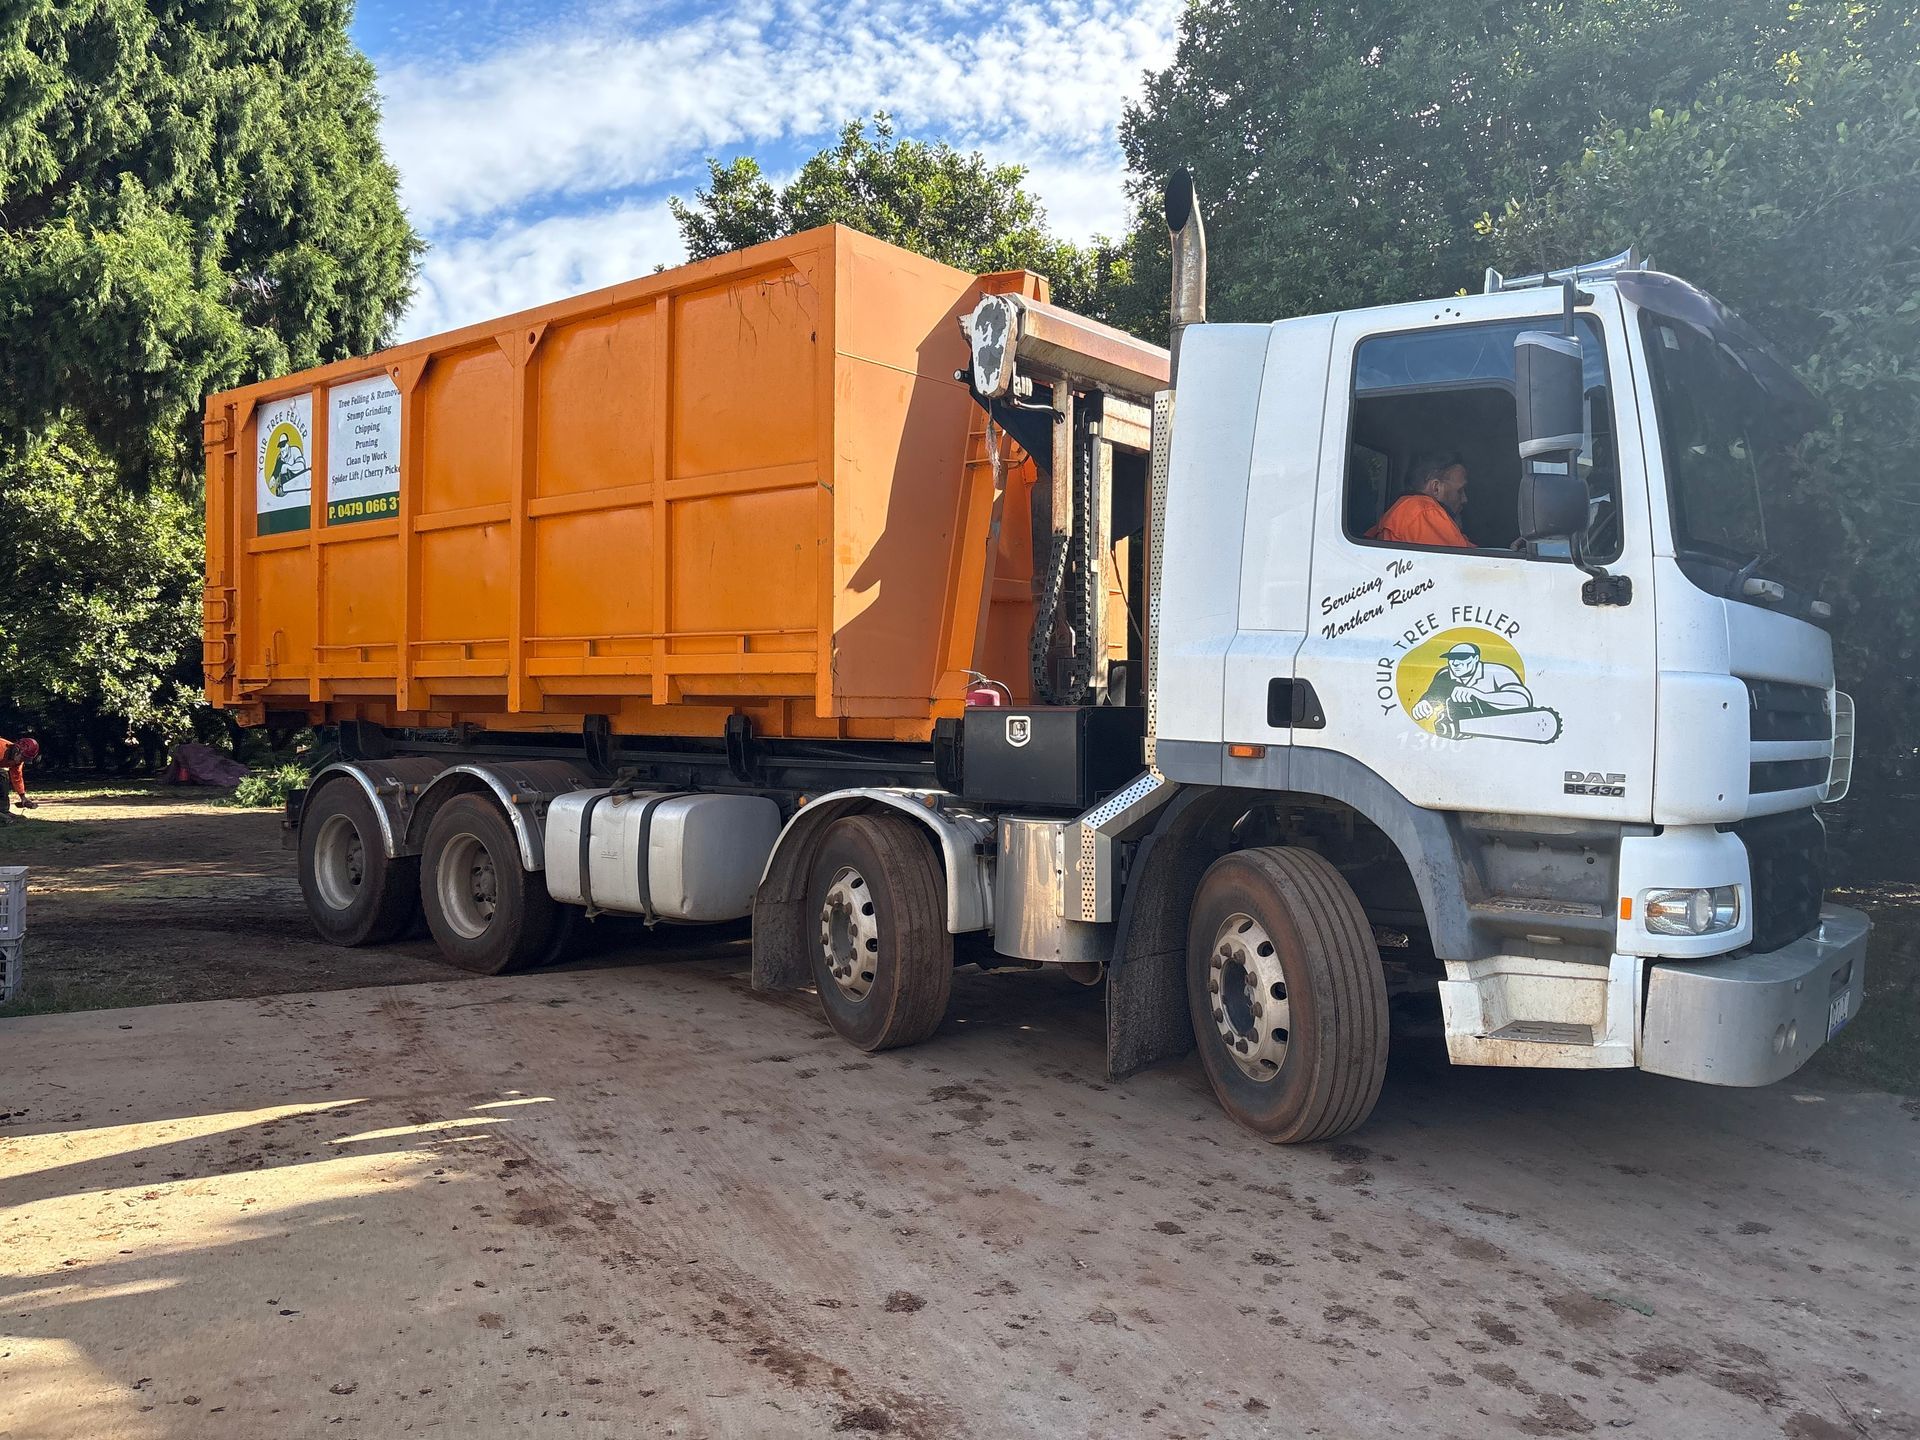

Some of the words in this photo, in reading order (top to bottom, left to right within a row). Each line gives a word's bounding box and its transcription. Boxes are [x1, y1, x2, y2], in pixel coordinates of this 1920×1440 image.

[338, 399, 350, 409] Tree
[351, 394, 370, 406] Felling
[370, 391, 376, 401] &
[346, 411, 365, 421] Stump
[365, 405, 392, 417] Grinding
[355, 422, 381, 435] Chipping
[258, 438, 268, 473] YOUR
[266, 411, 283, 433] TREE
[286, 410, 308, 440] FELLER
[355, 438, 379, 450] Pruning
[346, 456, 362, 466] Clean
[362, 454, 371, 465] Up
[372, 450, 388, 461] Work
[331, 474, 348, 485] Spider
[349, 470, 359, 481] Lift
[364, 468, 384, 478] Cherry
[328, 506, 337, 519] P.
[337, 501, 364, 518] 0479
[365, 497, 387, 514] 066
[1321, 577, 1383, 616] Servicing
[1386, 558, 1414, 578] The
[1321, 604, 1384, 640] Northern
[1386, 578, 1435, 610] Rivers
[1376, 657, 1397, 716] YOUR
[1393, 612, 1440, 650] TREE
[1451, 605, 1520, 639] FELLER
[1564, 771, 1626, 785] DAF
